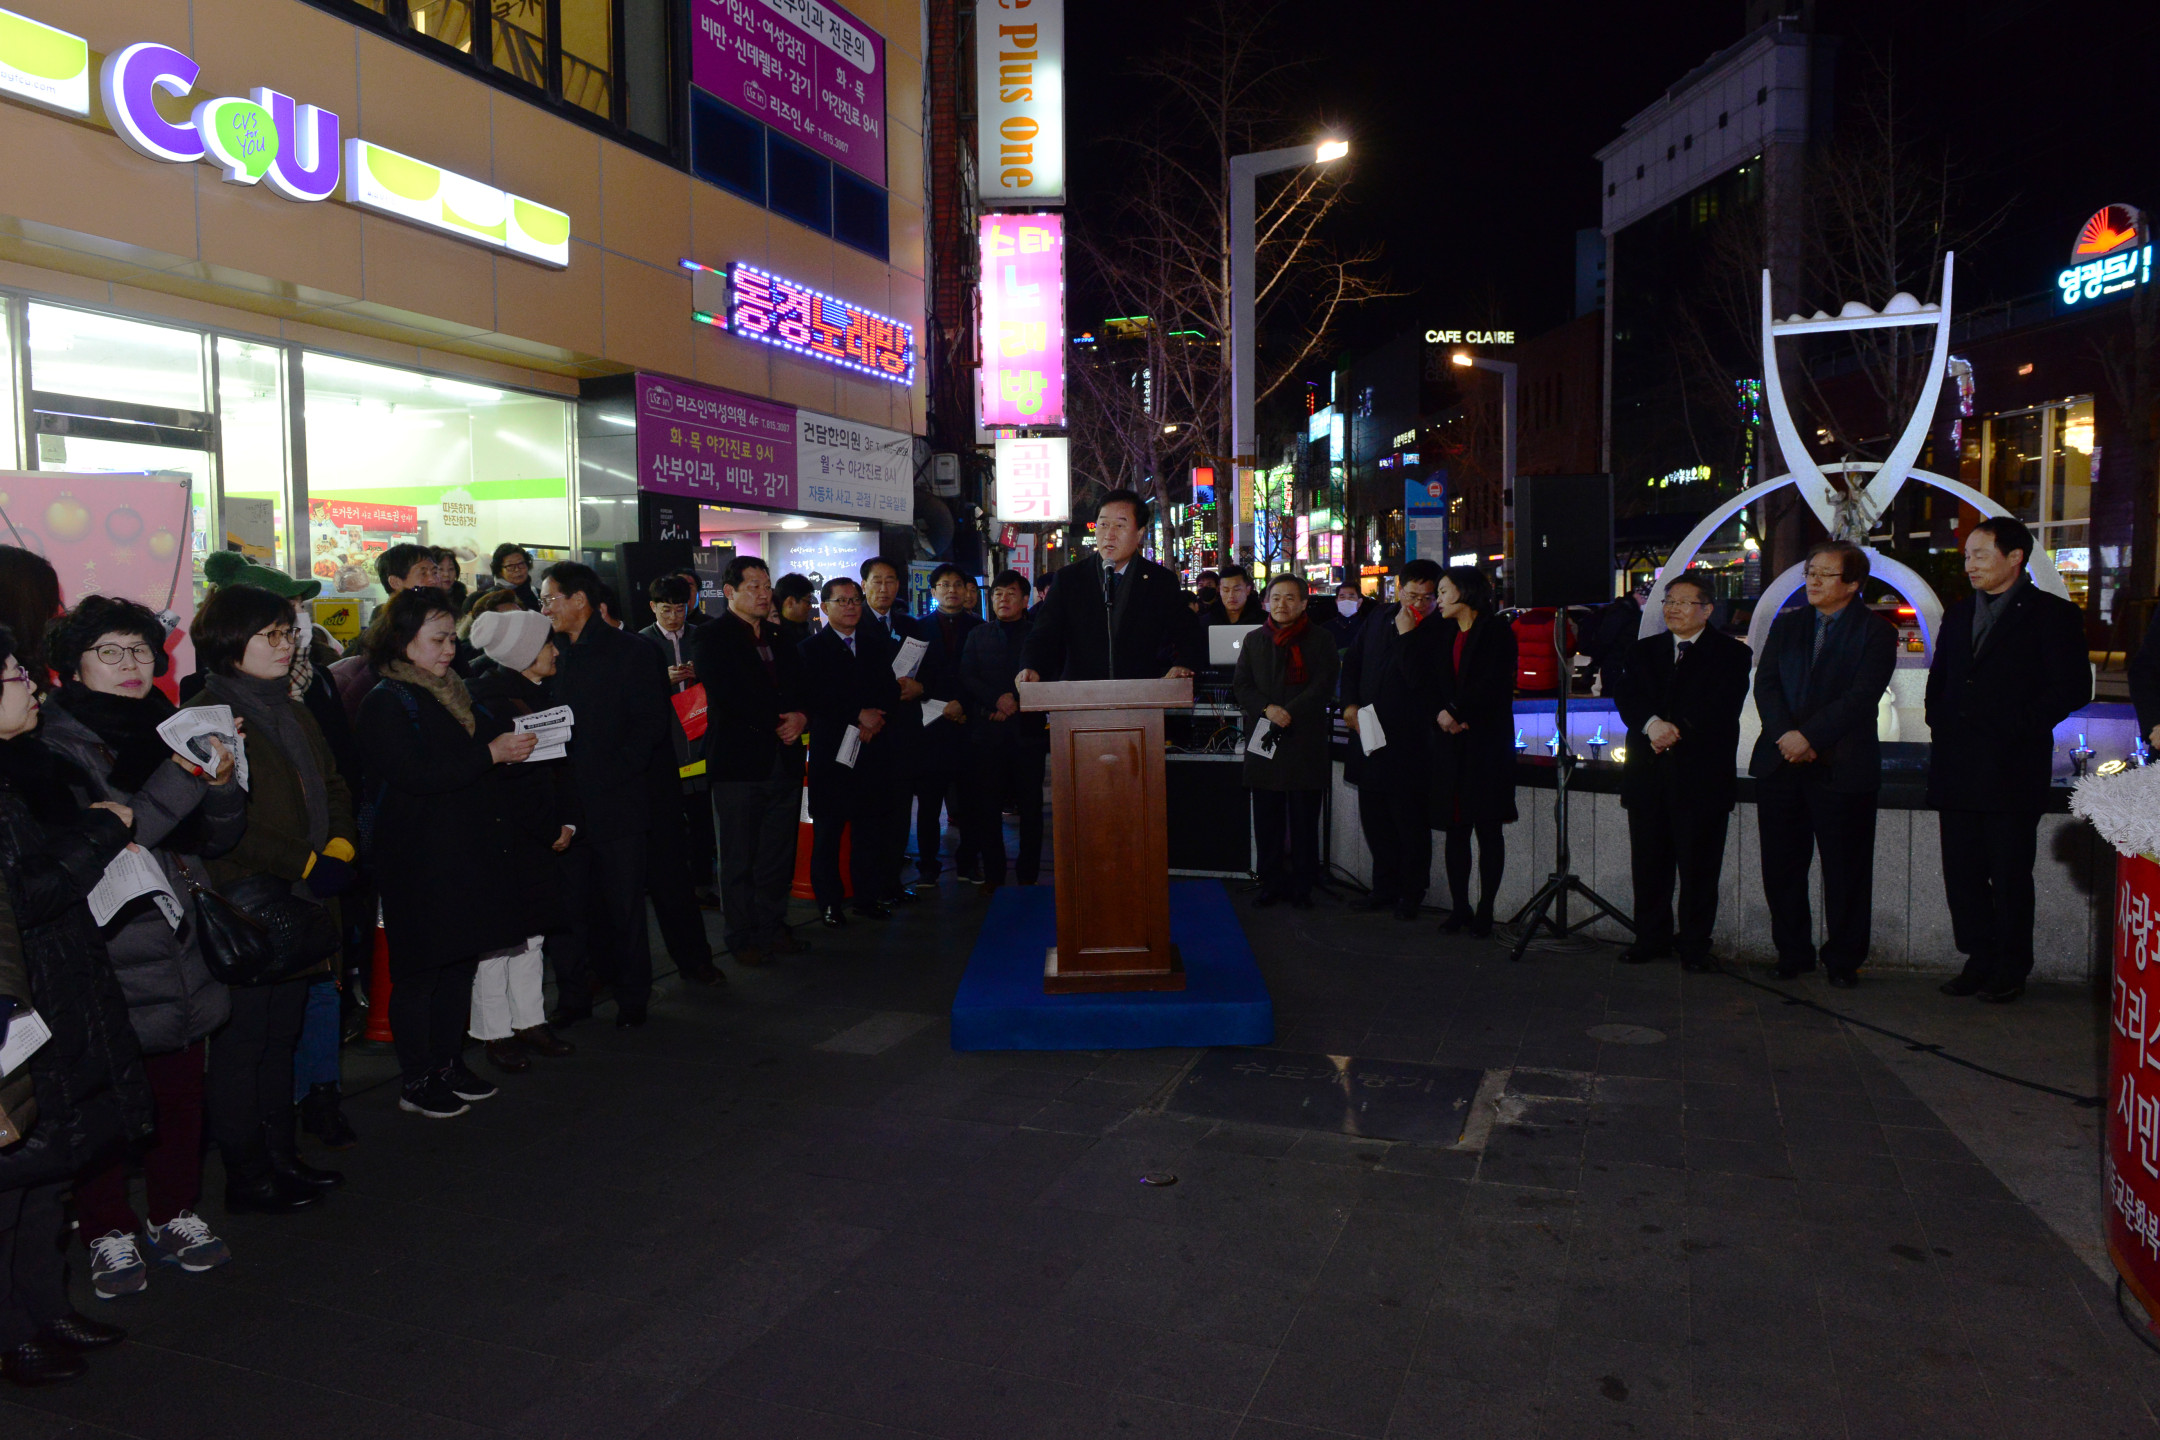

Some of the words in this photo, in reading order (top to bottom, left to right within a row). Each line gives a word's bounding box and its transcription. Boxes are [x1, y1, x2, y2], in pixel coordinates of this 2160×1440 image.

[772, 0, 824, 33] 부인과
[829, 18, 865, 62] 전문의
[233, 112, 258, 130] CVS
[770, 95, 801, 132] 리즈인
[804, 117, 815, 134] 4F
[822, 89, 861, 127] 야간진료
[863, 114, 878, 139] 9시
[236, 136, 265, 158] YOU
[245, 130, 258, 139] for
[1000, 116, 1039, 189] One
[990, 225, 1055, 256] 스타
[736, 268, 908, 374] 동경노래방
[999, 265, 1048, 415] 노래방
[1425, 330, 1462, 343] CAFE
[1466, 331, 1515, 344] CLAIRE
[676, 394, 746, 427] 리즈인여성의원
[749, 413, 759, 427] 4F
[706, 435, 752, 460] 야간진료
[755, 444, 774, 463] 9시
[804, 422, 860, 451] 건담한의원
[864, 437, 874, 451] 3F
[652, 454, 720, 491] 산부인과,
[726, 466, 758, 496] 비만,
[763, 473, 789, 498] 감기
[848, 460, 883, 481] 야간진료
[884, 467, 897, 484] 8시
[1012, 443, 1052, 517] 고래고기
[442, 502, 476, 515] 따뜻하게,
[809, 485, 834, 503] 자동차
[332, 506, 360, 519] 뜨거운거
